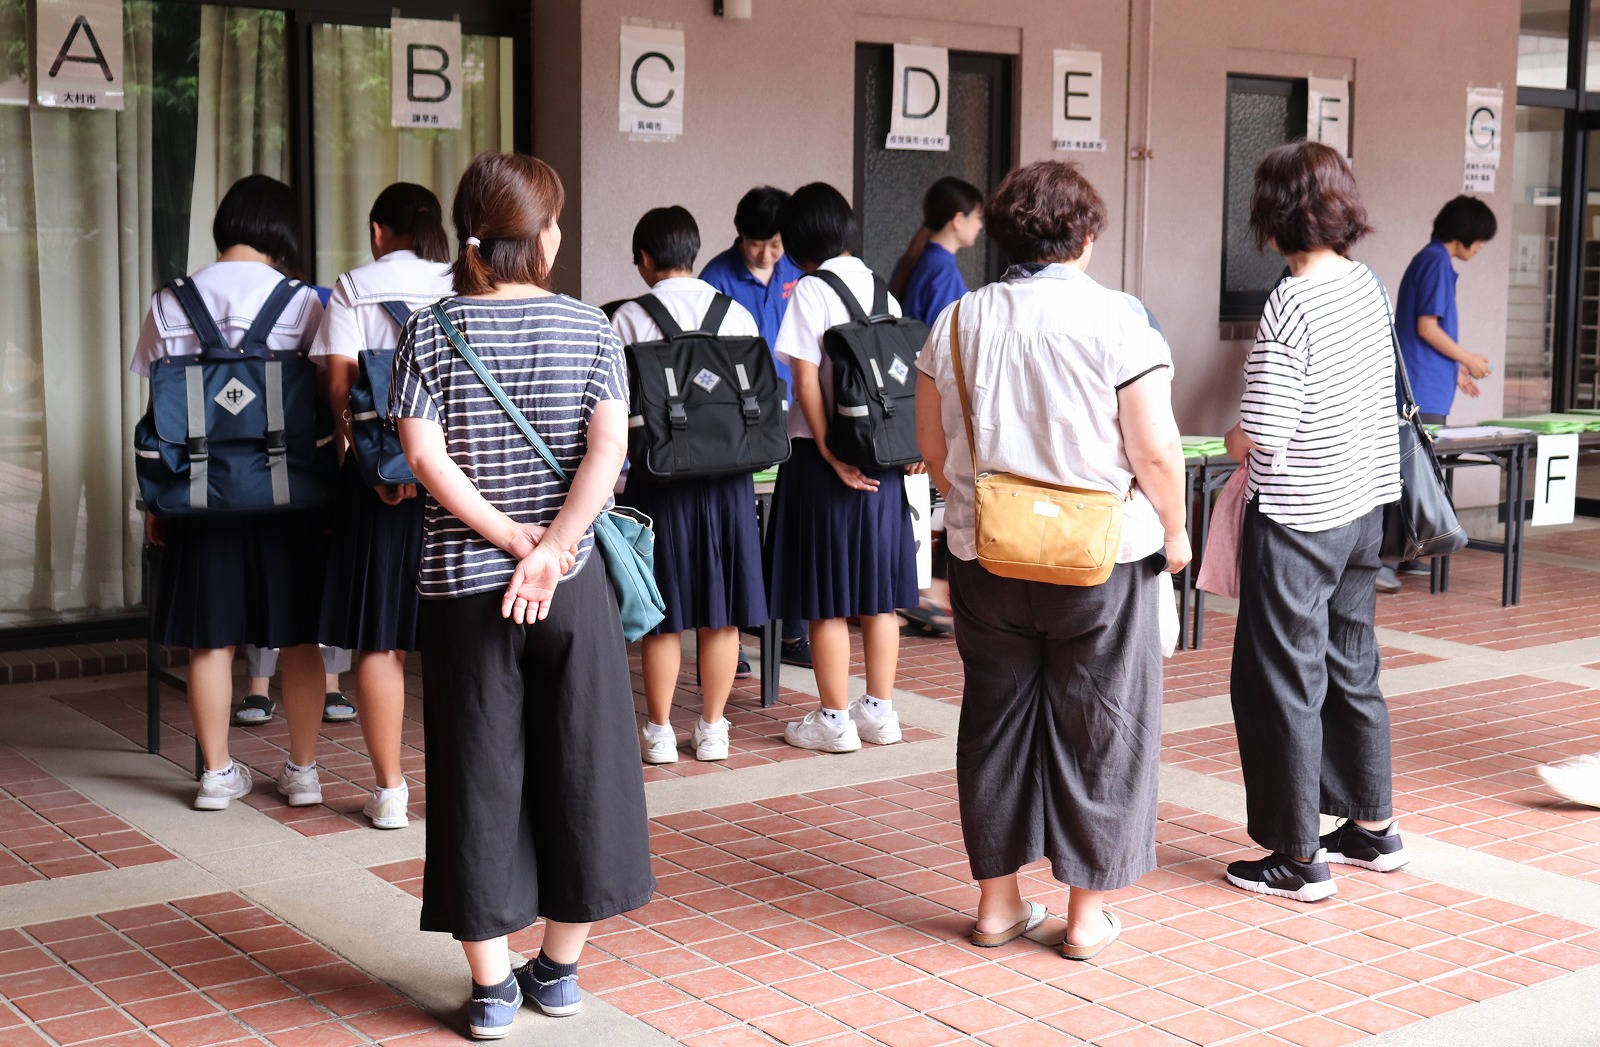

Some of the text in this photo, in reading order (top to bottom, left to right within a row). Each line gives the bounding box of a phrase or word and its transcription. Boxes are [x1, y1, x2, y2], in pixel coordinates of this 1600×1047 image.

[49, 15, 113, 81] A
[407, 43, 451, 103] B
[63, 92, 96, 104] 大村市
[630, 51, 675, 108] C
[903, 66, 940, 118] D
[1064, 71, 1092, 121] E
[1318, 97, 1341, 143] F
[1470, 106, 1495, 150] G
[1545, 455, 1570, 504] F
